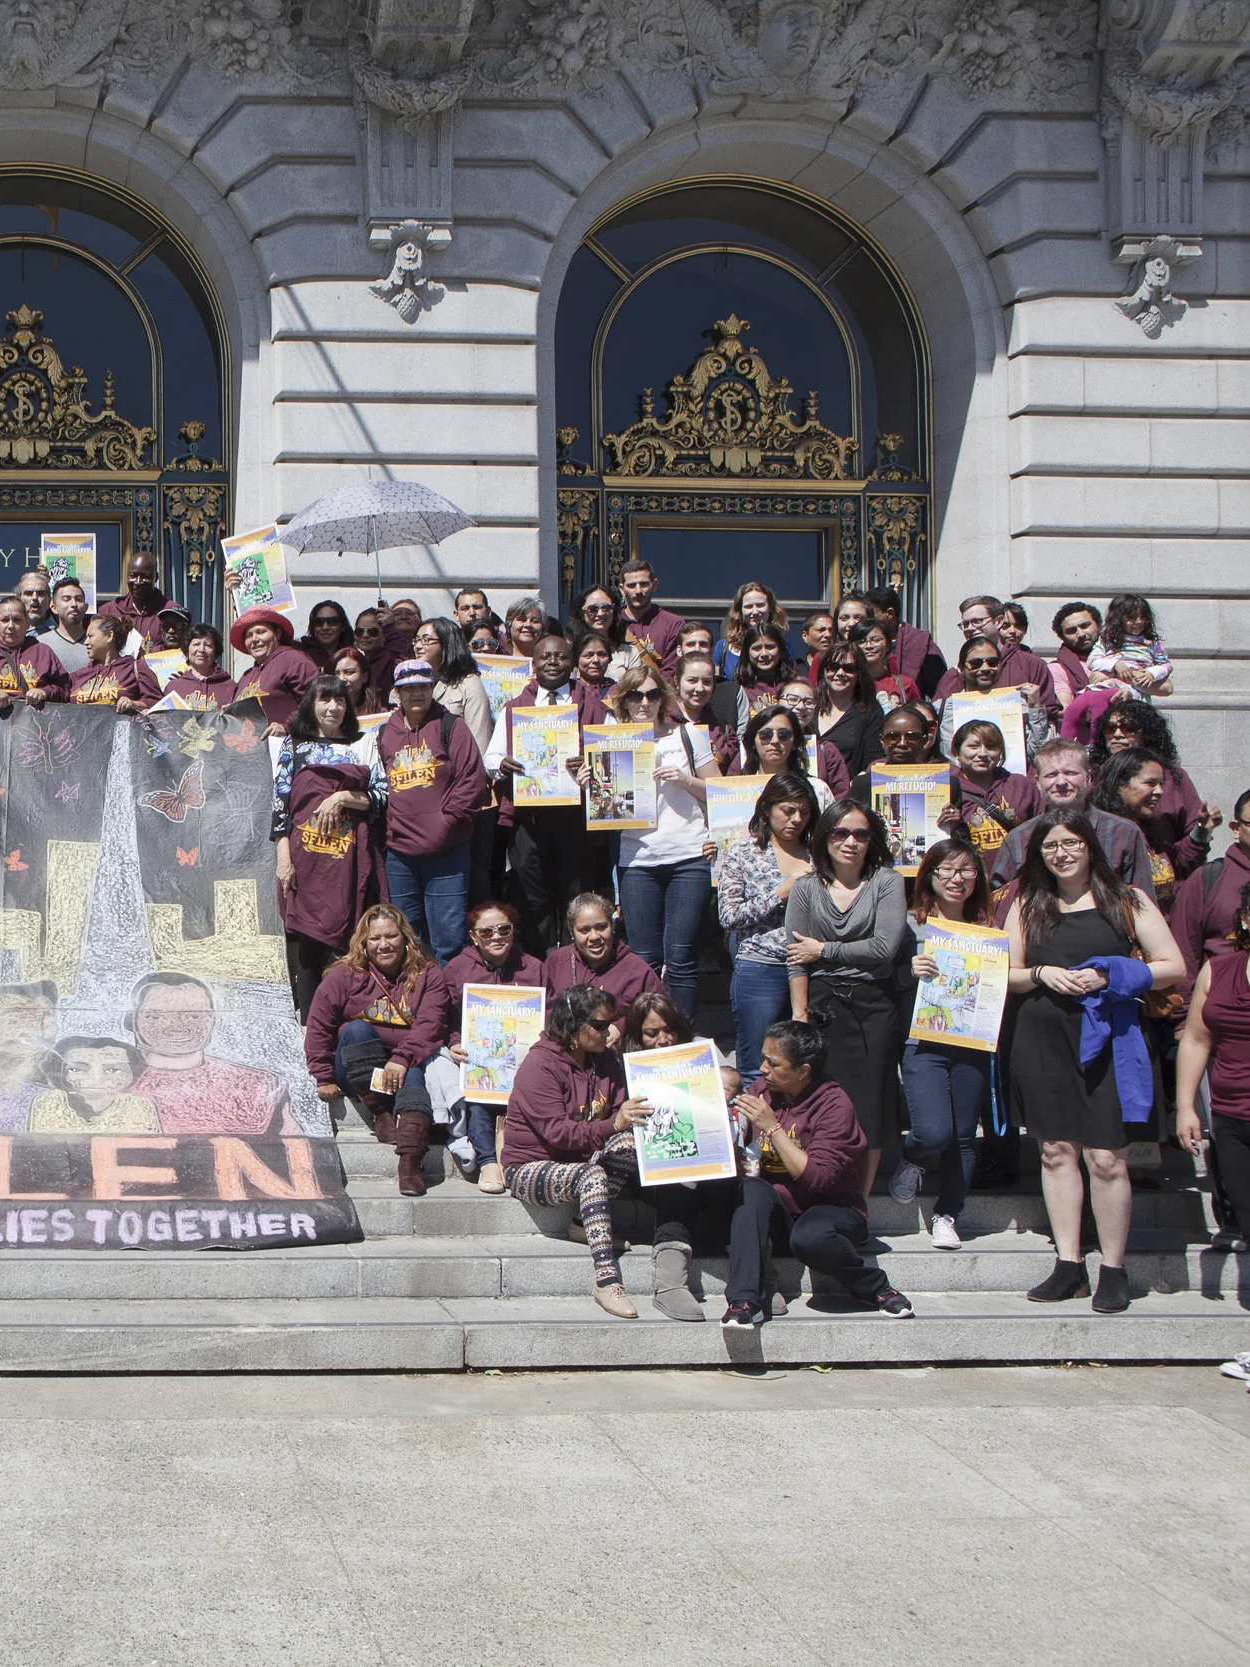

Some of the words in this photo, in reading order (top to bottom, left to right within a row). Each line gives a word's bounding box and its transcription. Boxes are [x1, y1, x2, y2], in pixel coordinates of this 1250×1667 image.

[488, 671, 527, 681] SANCTUARY!
[516, 720, 530, 731] MY
[530, 719, 574, 731] SANCTUARY!
[597, 739, 609, 750] MI
[610, 739, 643, 750] REFUGIO!
[390, 767, 436, 787] SFILEN
[885, 781, 898, 792] MI
[899, 781, 937, 792] REFUGIO!
[301, 831, 351, 853] SFILEN
[971, 828, 1008, 845] SFIL
[930, 935, 947, 948] MY
[947, 938, 1004, 958] SANCTUARY!
[471, 1003, 485, 1014] MY
[486, 1004, 537, 1017] SANCTUARY!
[85, 1208, 317, 1244] TOGETHER
